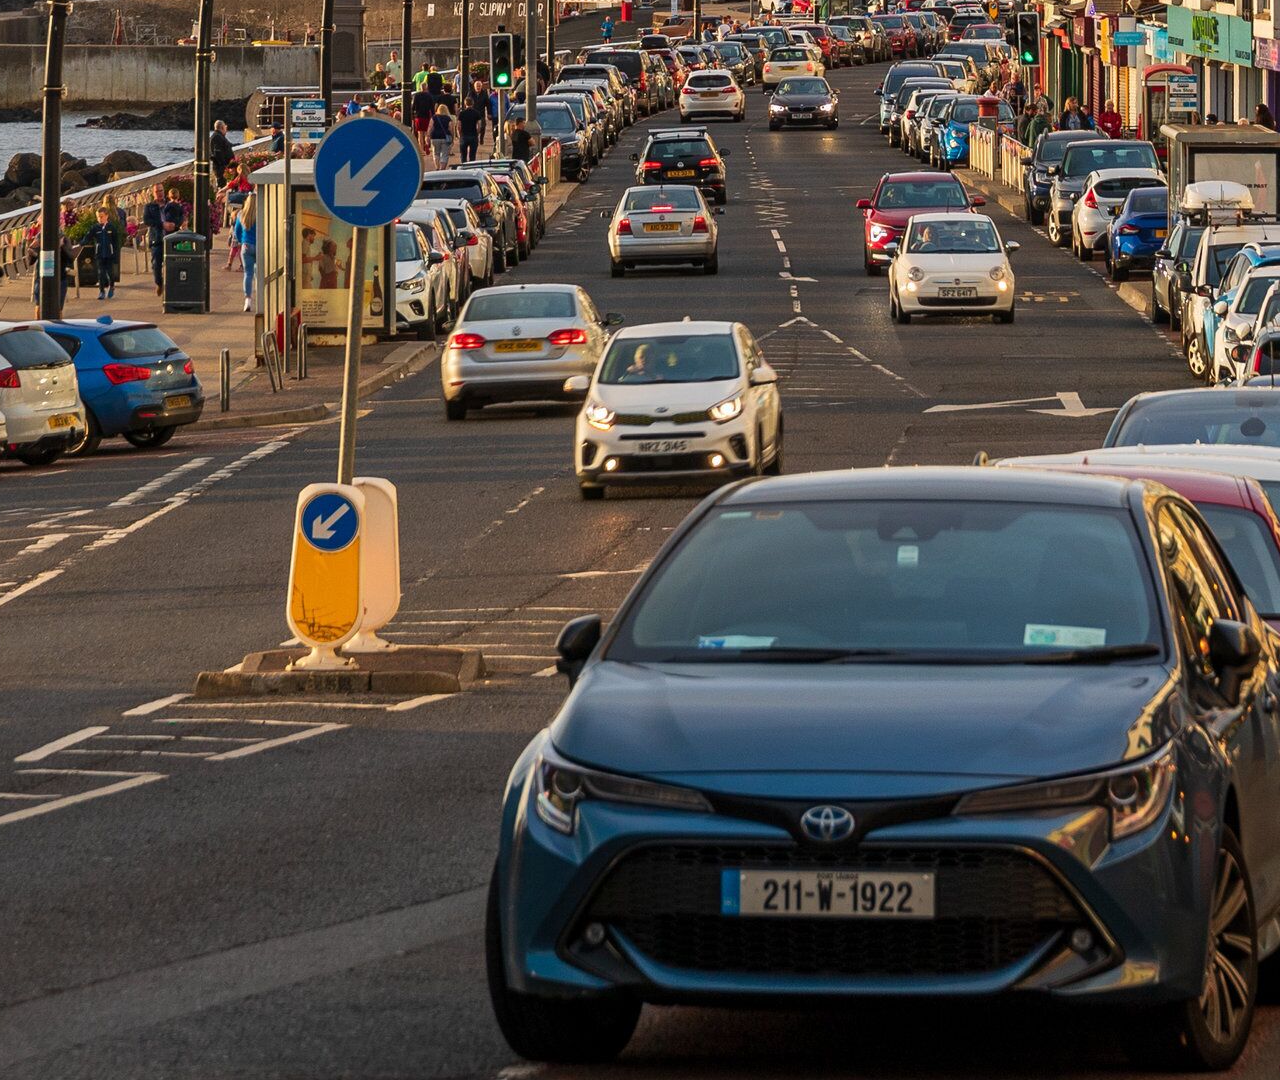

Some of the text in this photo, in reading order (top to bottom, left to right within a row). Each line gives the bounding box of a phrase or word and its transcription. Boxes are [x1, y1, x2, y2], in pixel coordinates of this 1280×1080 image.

[453, 2, 474, 16] KEP
[518, 2, 544, 16] CLR
[942, 289, 973, 297] SFZ 6417
[763, 879, 913, 913] 211-W-1922
